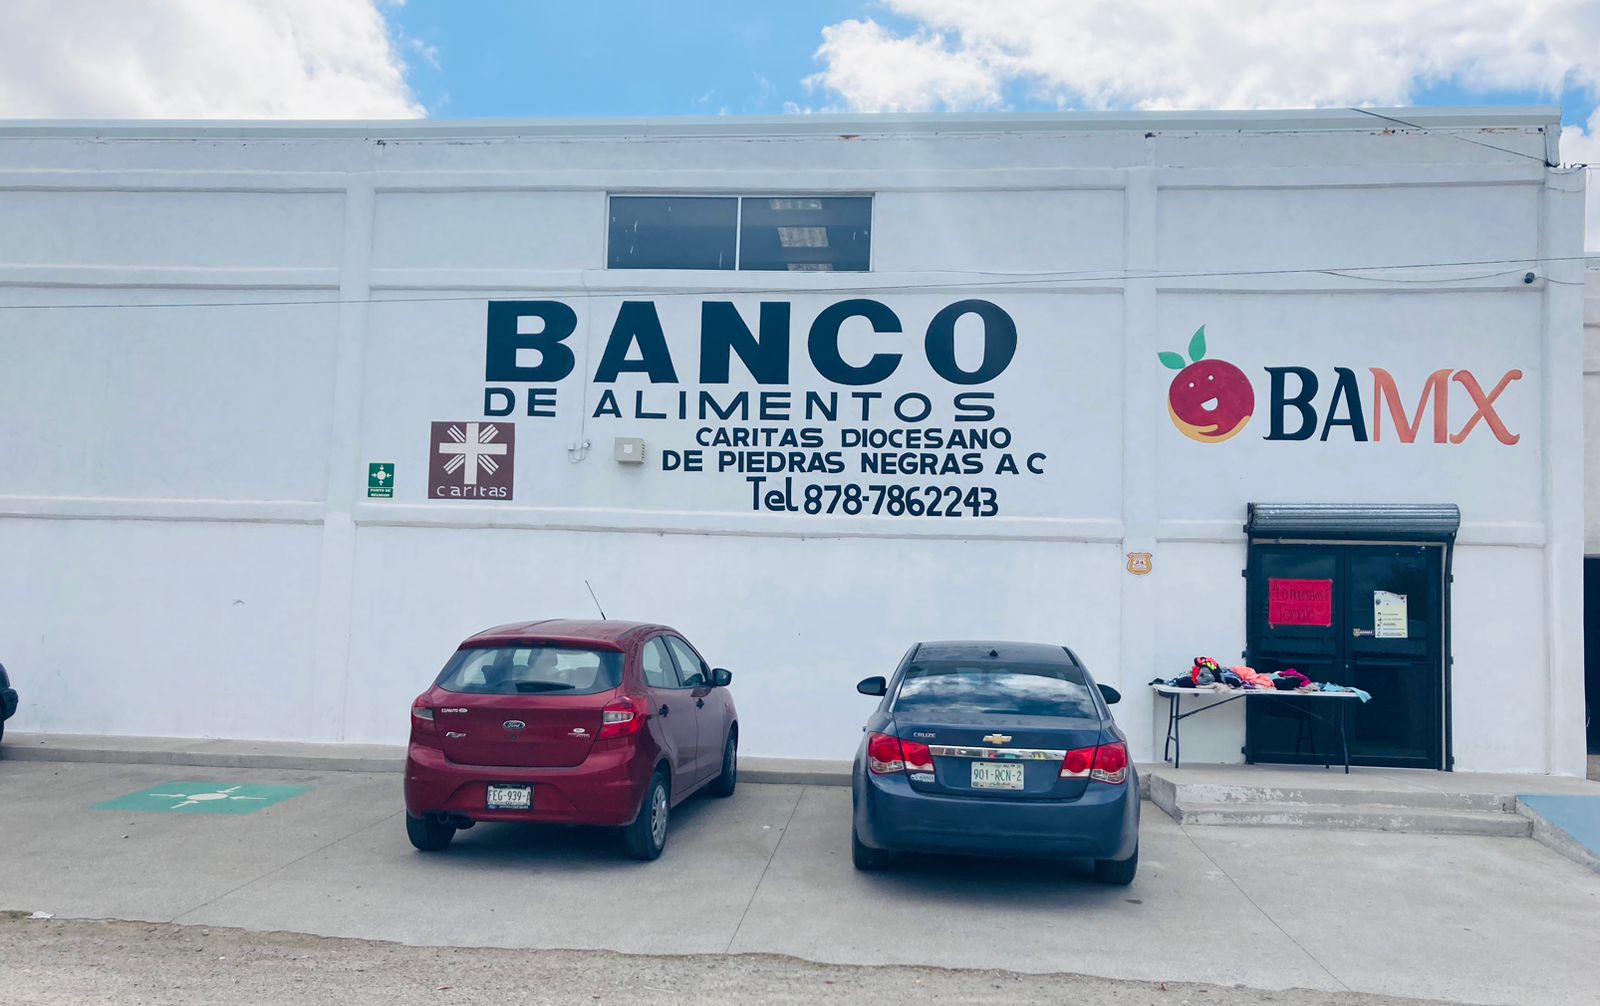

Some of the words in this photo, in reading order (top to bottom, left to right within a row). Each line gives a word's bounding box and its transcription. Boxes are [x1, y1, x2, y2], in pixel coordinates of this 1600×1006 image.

[486, 299, 1017, 385] BANCO
[484, 388, 557, 417] DE
[592, 390, 995, 422] ALIMENTOS
[1263, 366, 1523, 445] BAMX
[696, 427, 823, 448] CARITAS
[841, 428, 1011, 450] DIOCESANO
[662, 450, 703, 471] DE
[718, 451, 845, 474] PIEDRAS
[861, 452, 983, 475] NEGRAS
[436, 486, 507, 497] caritas
[746, 476, 799, 512] Tel
[803, 484, 999, 518] 878-7862243
[973, 768, 1022, 782] 901-RCN-2
